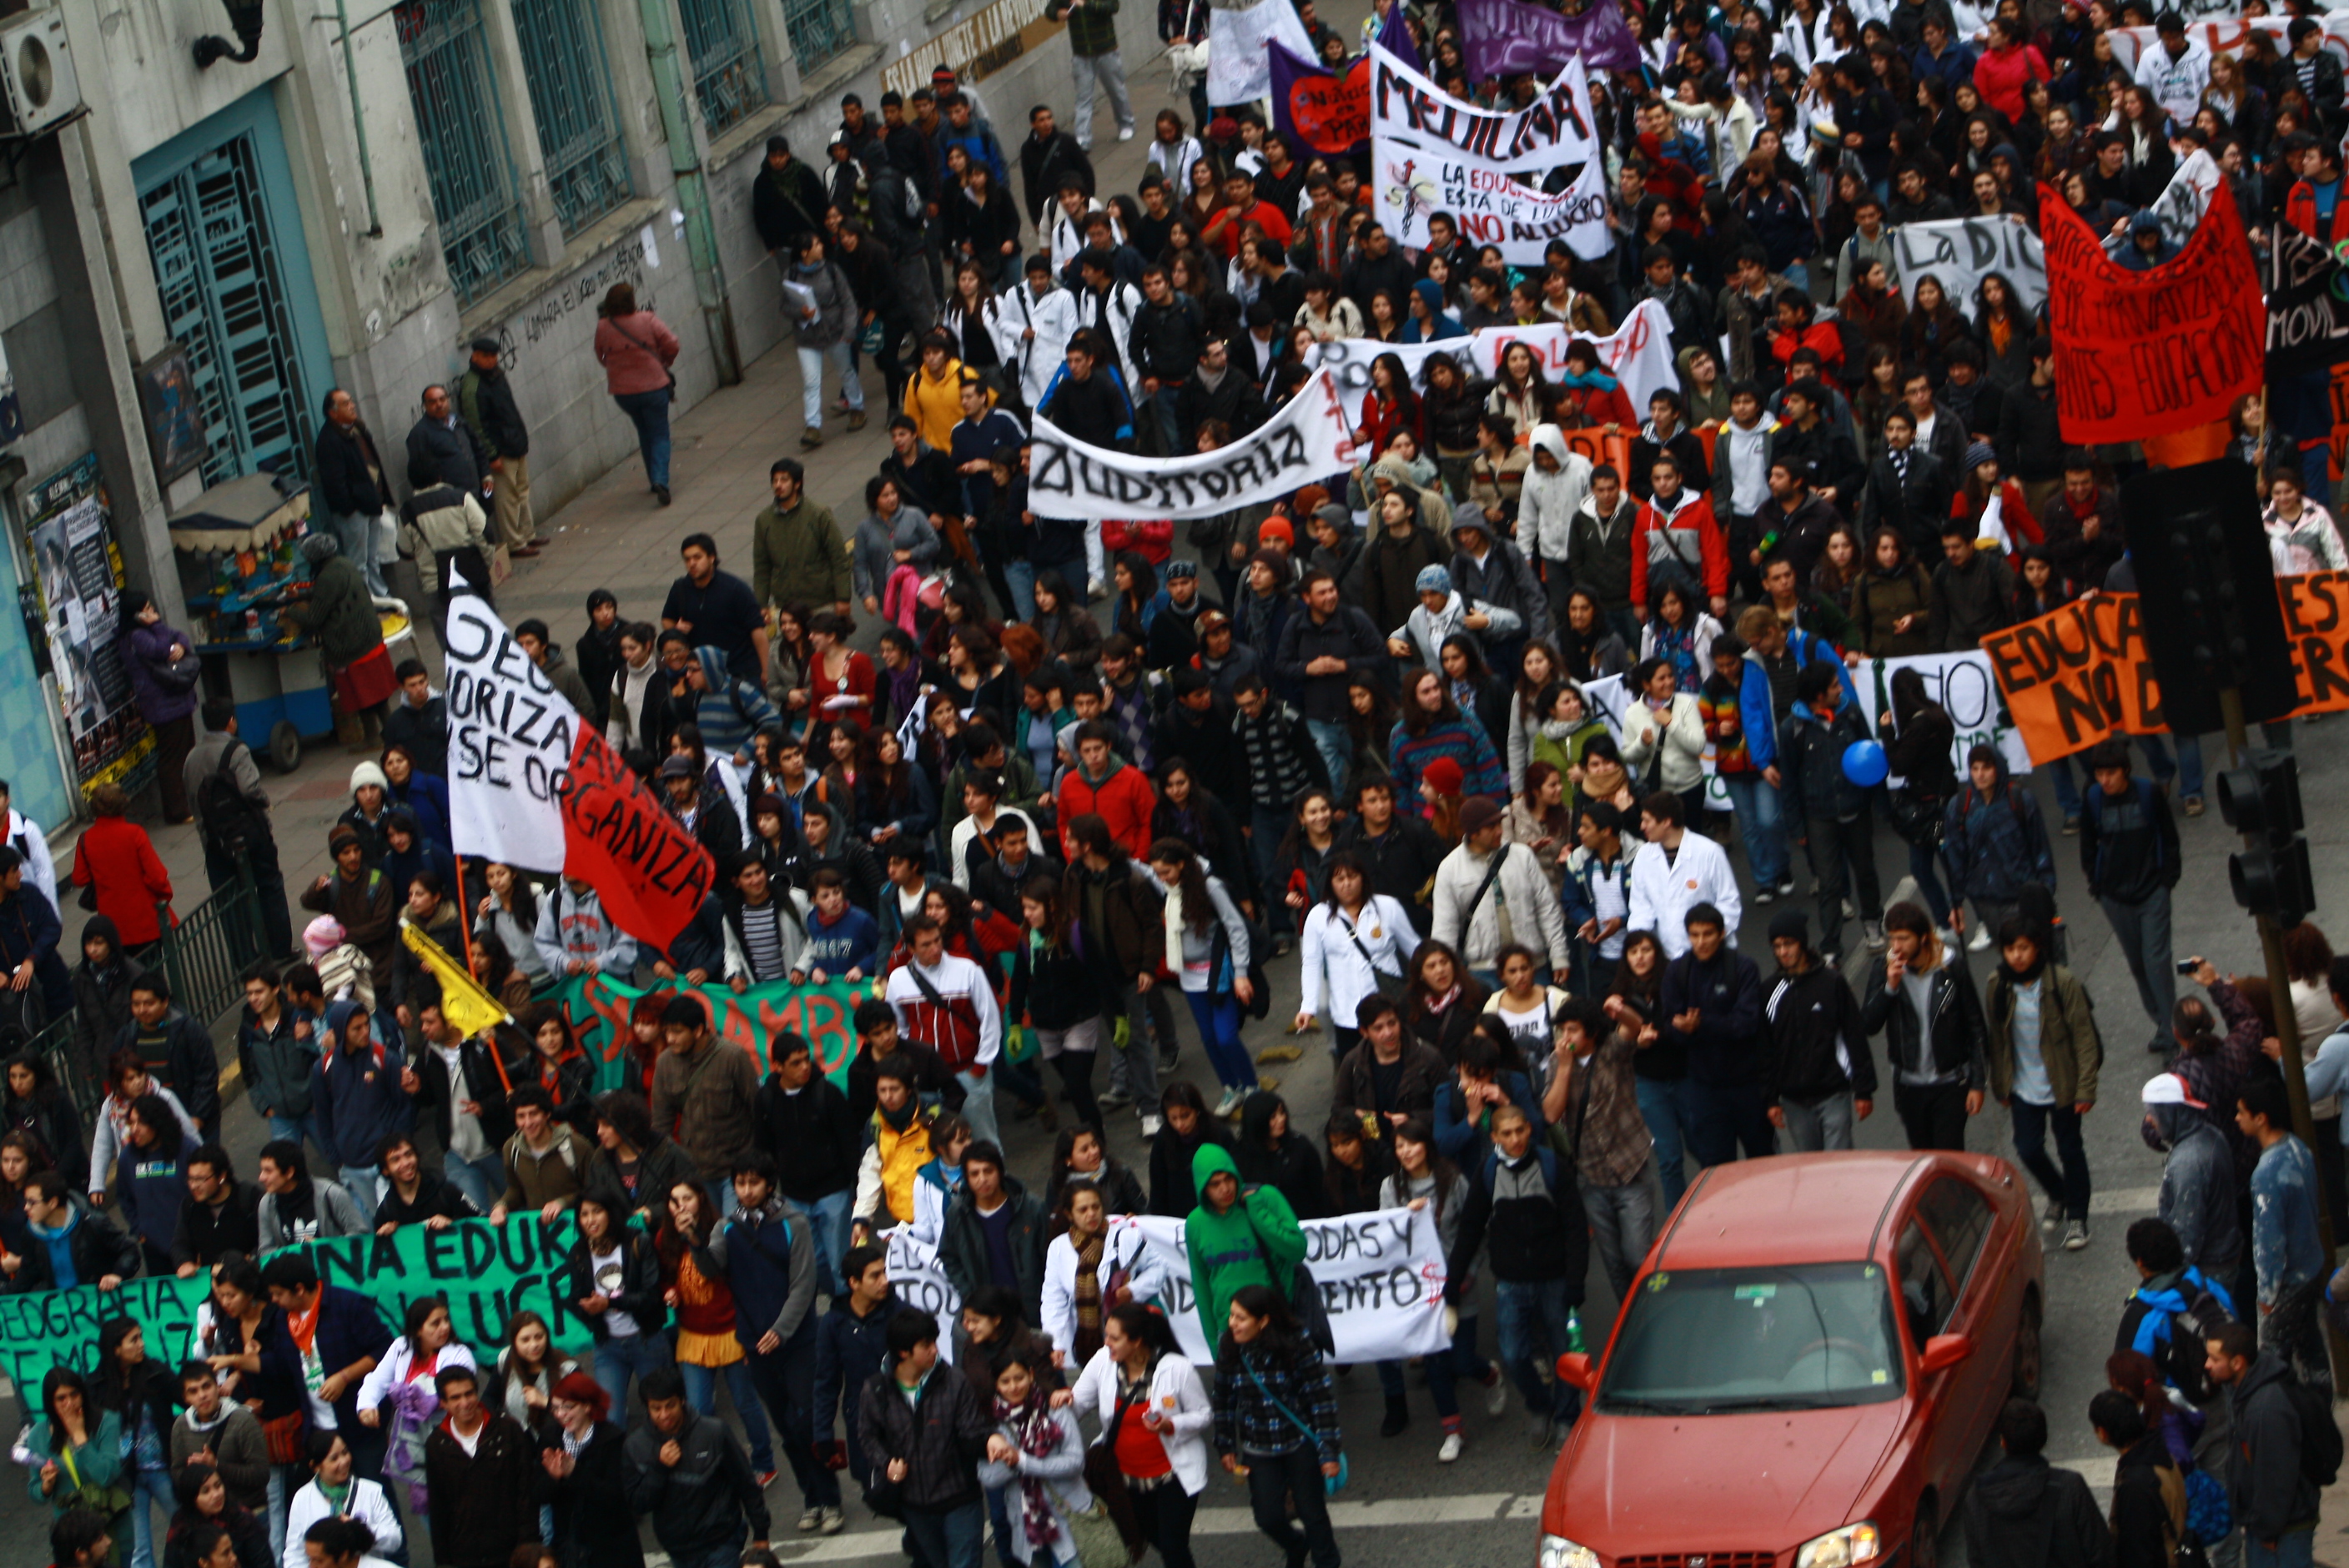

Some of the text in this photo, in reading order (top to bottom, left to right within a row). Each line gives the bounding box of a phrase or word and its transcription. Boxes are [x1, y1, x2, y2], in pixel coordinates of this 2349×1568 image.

[978, 13, 989, 53] A
[1441, 162, 1466, 185] LA
[1459, 193, 1607, 243] NO AL LUCRO
[1501, 198, 1524, 220] DE
[1987, 596, 2150, 696] EDUCA
[456, 726, 512, 791] SE
[524, 755, 709, 911] ORGANIZA
[1305, 1220, 1383, 1262] ODAS
[1388, 1215, 1412, 1258] Y
